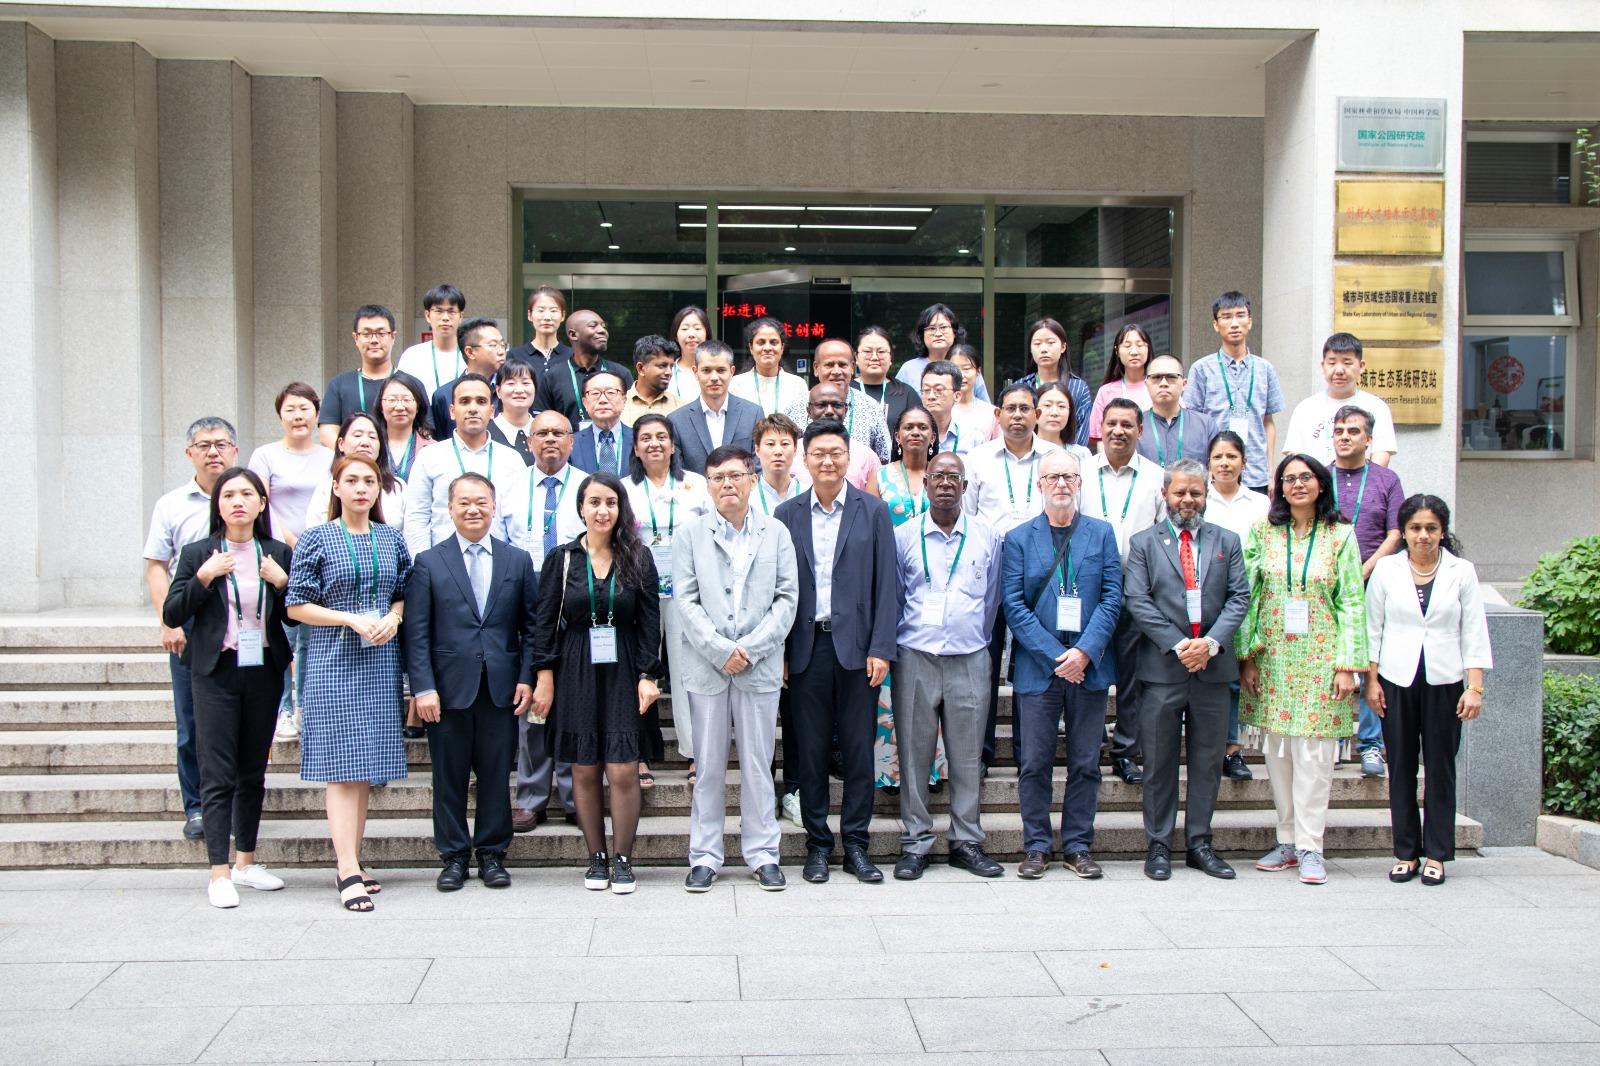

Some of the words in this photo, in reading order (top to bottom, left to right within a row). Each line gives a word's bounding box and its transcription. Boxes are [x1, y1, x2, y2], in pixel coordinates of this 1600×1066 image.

[1358, 130, 1425, 140] 国家公园研究院
[1343, 291, 1437, 303] 城市与区域生态国家重点实验室
[1399, 395, 1419, 404] Research
[1420, 395, 1437, 404] Station
